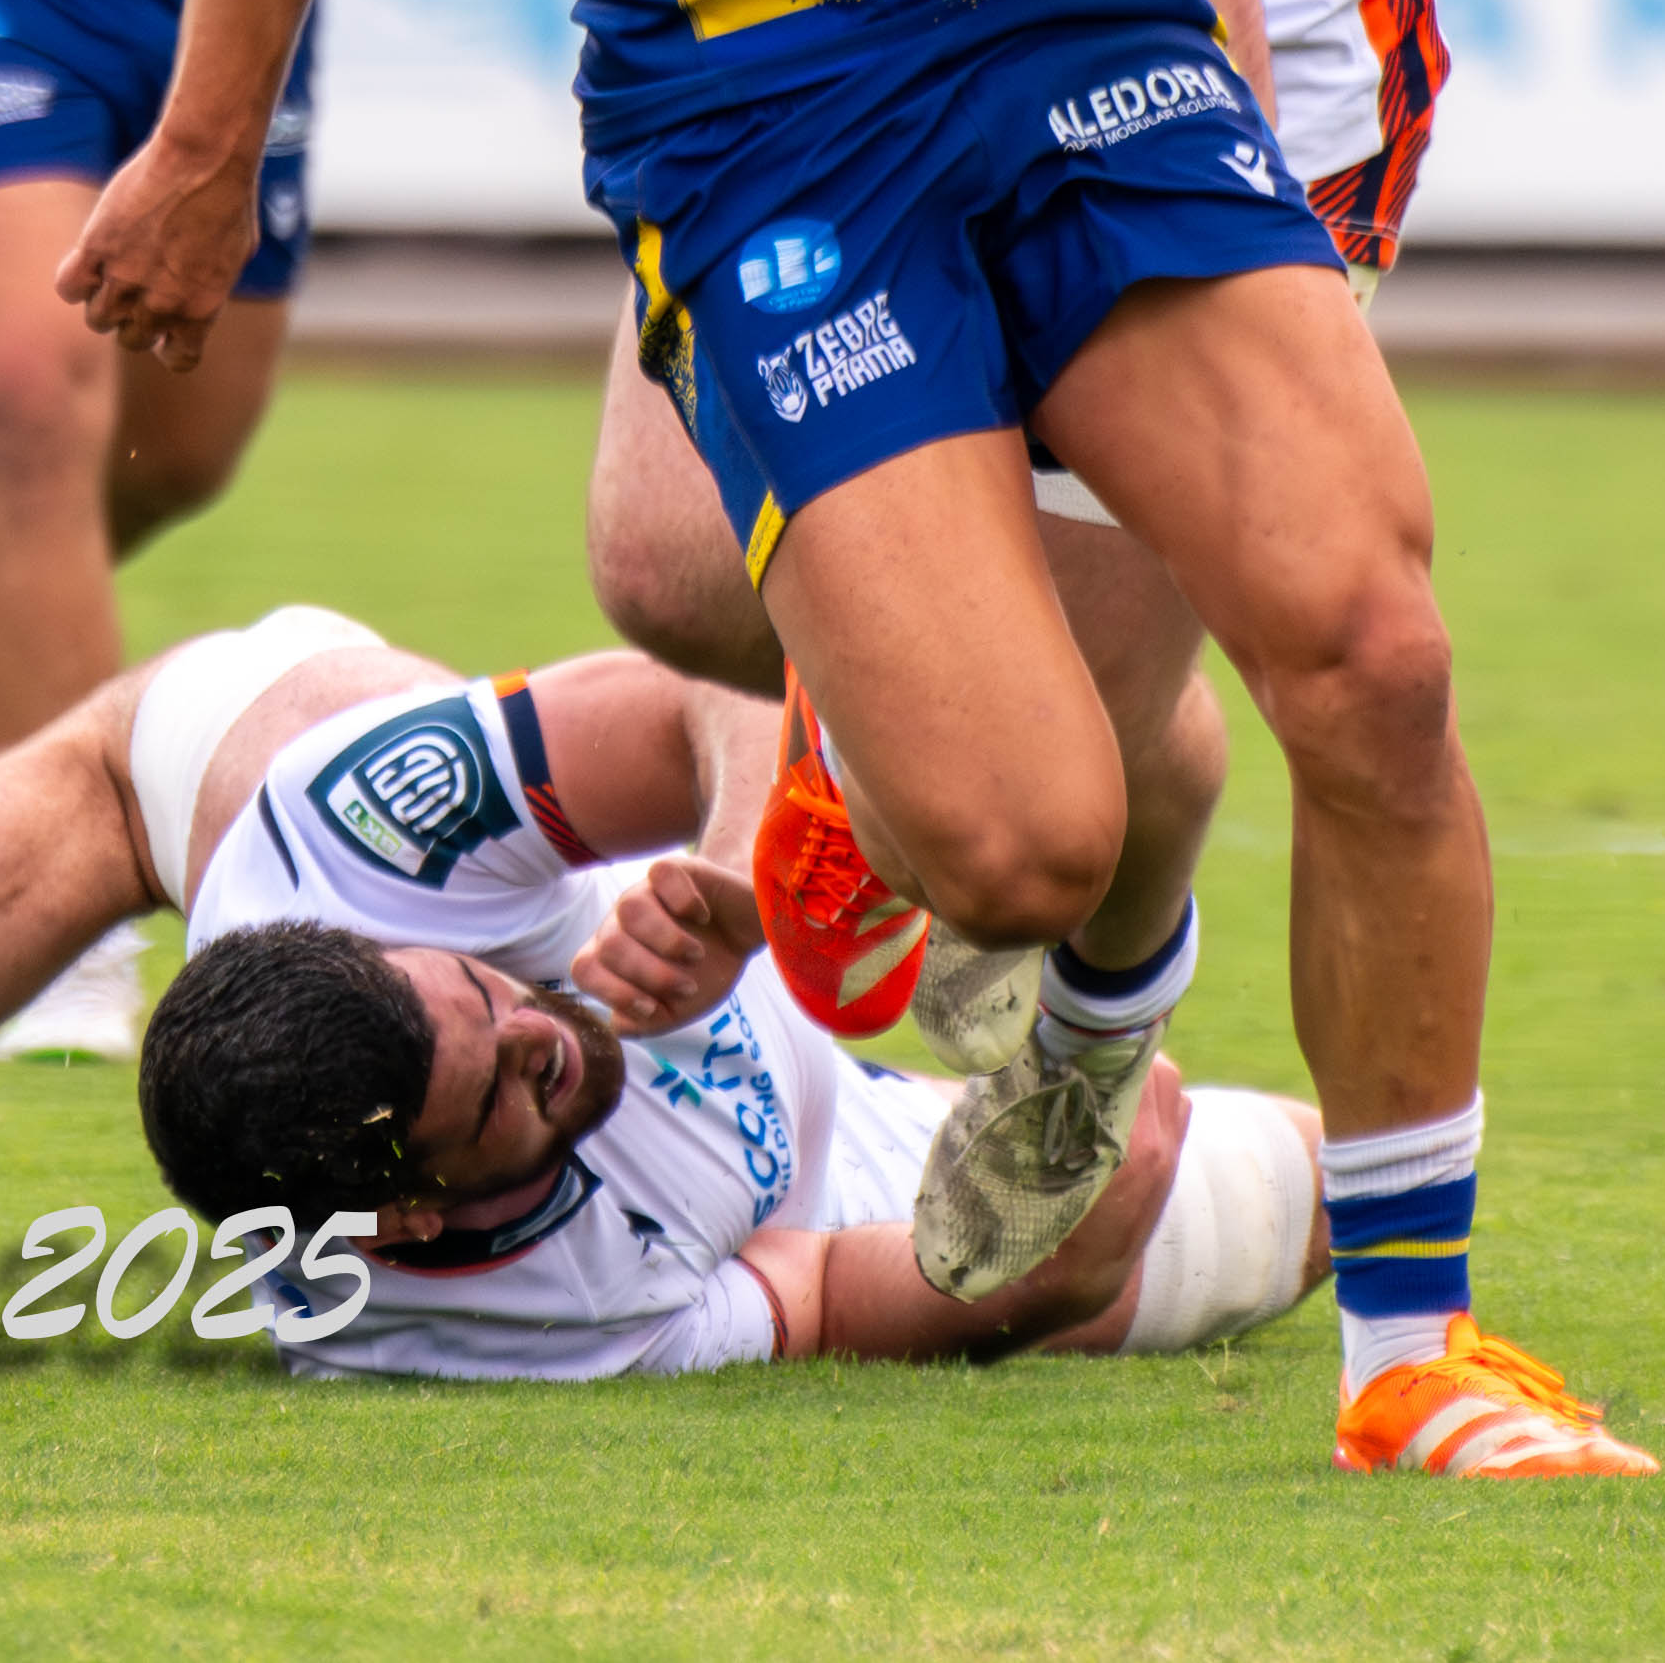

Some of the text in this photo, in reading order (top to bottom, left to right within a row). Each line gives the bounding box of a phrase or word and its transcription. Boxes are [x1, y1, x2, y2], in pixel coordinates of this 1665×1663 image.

[1048, 63, 1231, 145] ALEDORA
[1104, 106, 1178, 148] MODULAR
[793, 289, 899, 381] ZEBRE
[811, 336, 918, 408] PARMA
[700, 1012, 778, 1228] SCOTTI
